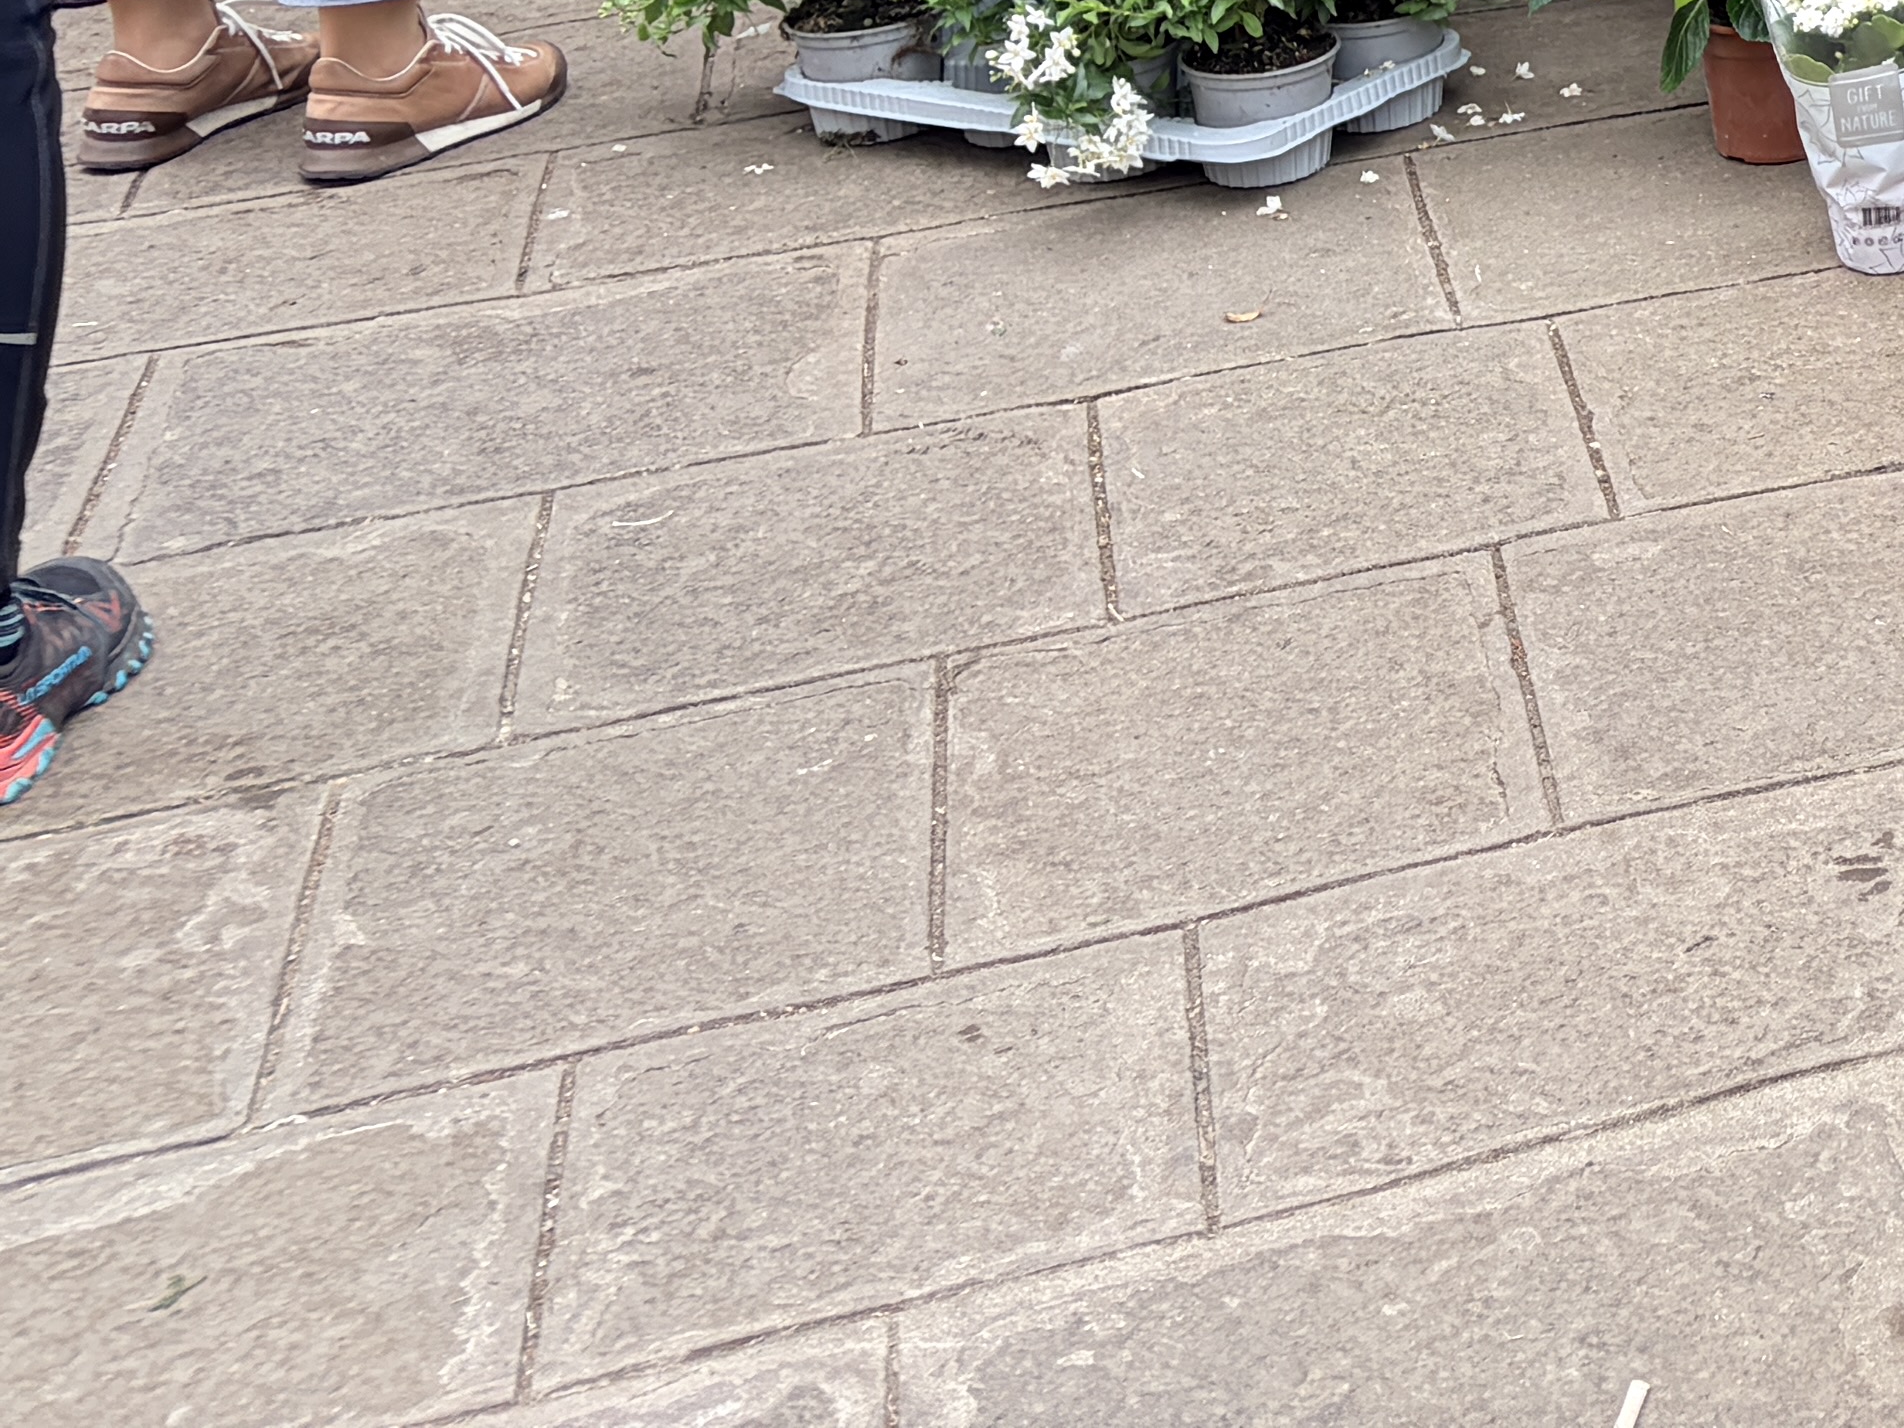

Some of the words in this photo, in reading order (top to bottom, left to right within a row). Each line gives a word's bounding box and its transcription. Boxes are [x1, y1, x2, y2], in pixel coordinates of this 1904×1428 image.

[1846, 83, 1885, 105] GIFT
[82, 118, 157, 135] ARPA
[1840, 109, 1898, 134] NATURE
[302, 128, 371, 145] ARPA
